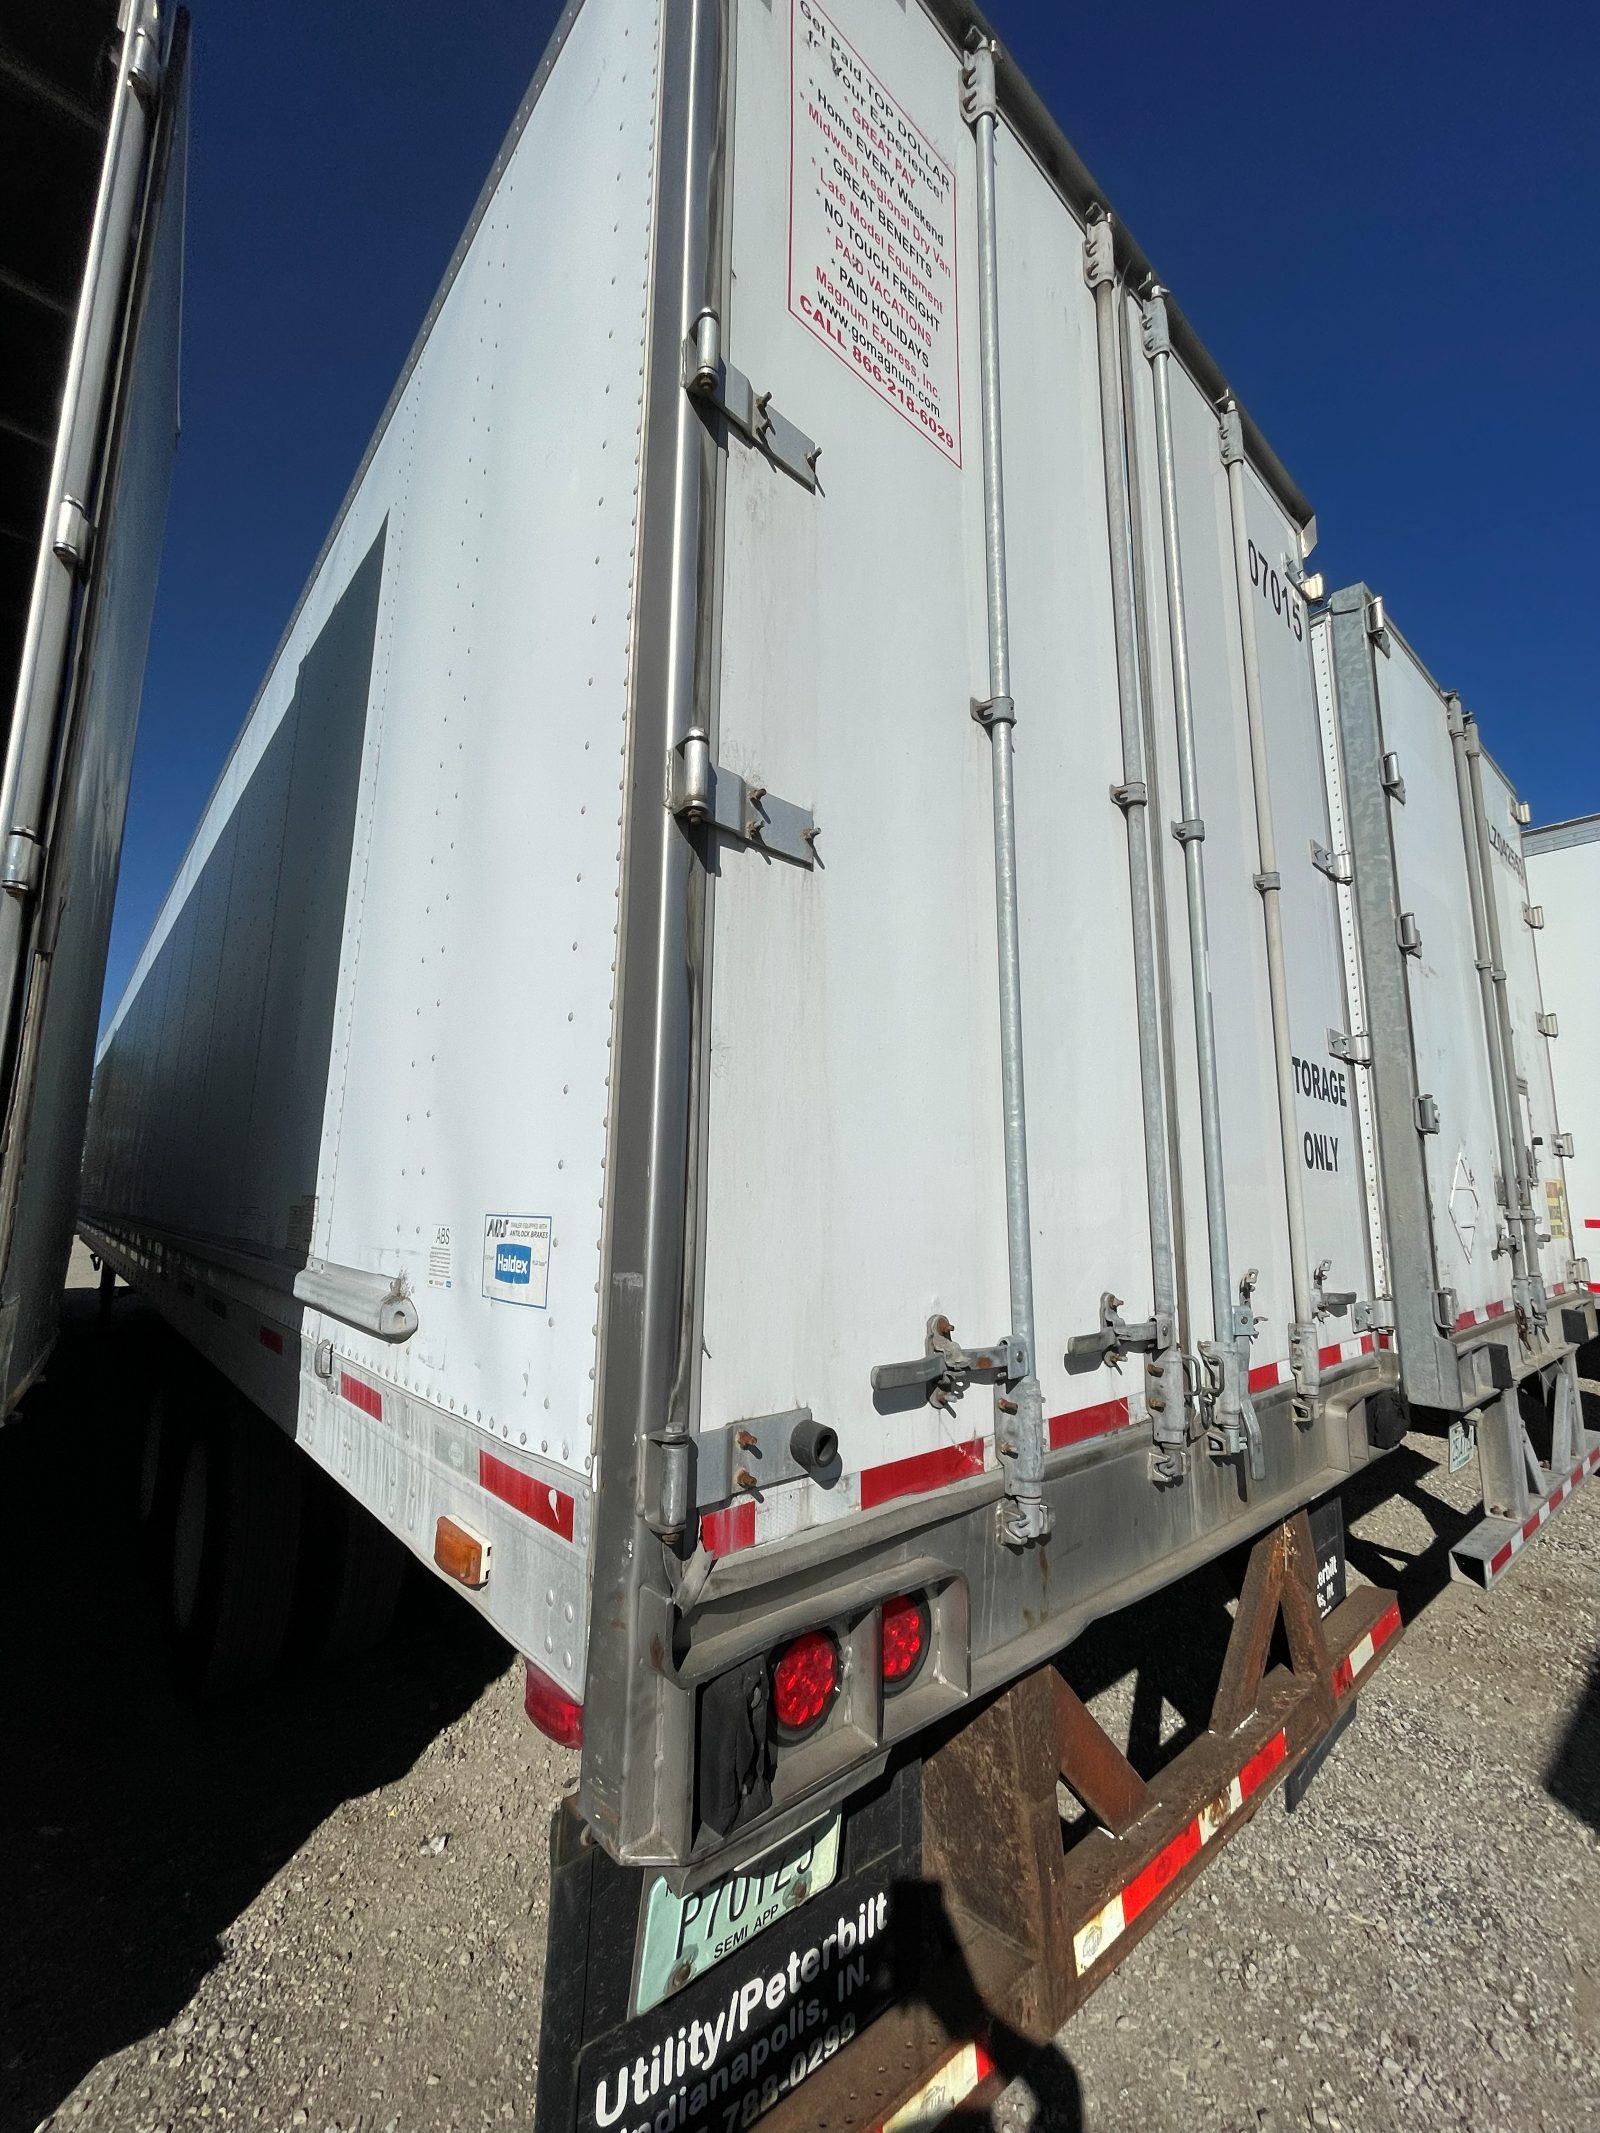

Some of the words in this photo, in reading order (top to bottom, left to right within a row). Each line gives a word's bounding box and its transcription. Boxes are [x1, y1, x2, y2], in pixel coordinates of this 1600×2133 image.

[800, 0, 826, 40] Get
[831, 36, 861, 83] Paid
[866, 78, 894, 119] TOP
[898, 119, 950, 193] DOLLAR
[852, 107, 892, 160] GREAT
[895, 158, 916, 189] PAY
[808, 102, 859, 171] Midwest
[862, 165, 910, 230] Regional
[913, 224, 930, 255] Dry
[933, 247, 951, 278] Van
[818, 88, 853, 139] Home
[856, 134, 895, 188] EVERY
[897, 183, 944, 247] Weekend
[870, 105, 944, 204] Experience!
[820, 167, 846, 206] Late
[850, 201, 884, 249] Model
[887, 243, 943, 314] Equipment
[825, 198, 844, 228] NO
[847, 222, 889, 280] TOUCH
[893, 272, 940, 332] FREIGHT
[833, 158, 875, 213] GREAT
[878, 208, 932, 279] BENEFITS
[816, 266, 868, 330] Magnum
[872, 324, 920, 382] Express,
[923, 373, 941, 401] Inc.
[835, 236, 864, 275] PAID
[867, 269, 932, 347] VACATIONS
[840, 266, 868, 305] PAID
[872, 300, 929, 368] HOLIDAYS
[800, 295, 847, 350] CALL
[852, 345, 954, 448] 866-218-6029
[817, 291, 940, 418] www.gomagnum.com
[1248, 539, 1302, 642] 07015
[1292, 1056, 1347, 1107] TORAGE
[1304, 1131, 1338, 1172] ONLY
[435, 1227, 450, 1245] ABS
[486, 1219, 509, 1238] ABS
[497, 1253, 528, 1275] Haldex
[530, 1230, 548, 1239] BRAKES
[713, 1924, 749, 1960] SEMI
[753, 1903, 779, 1932] APP
[595, 1891, 888, 2127] Utility/Peterbilt
[619, 1998, 828, 2133] dianapolis,
[838, 1955, 870, 2001] IN.
